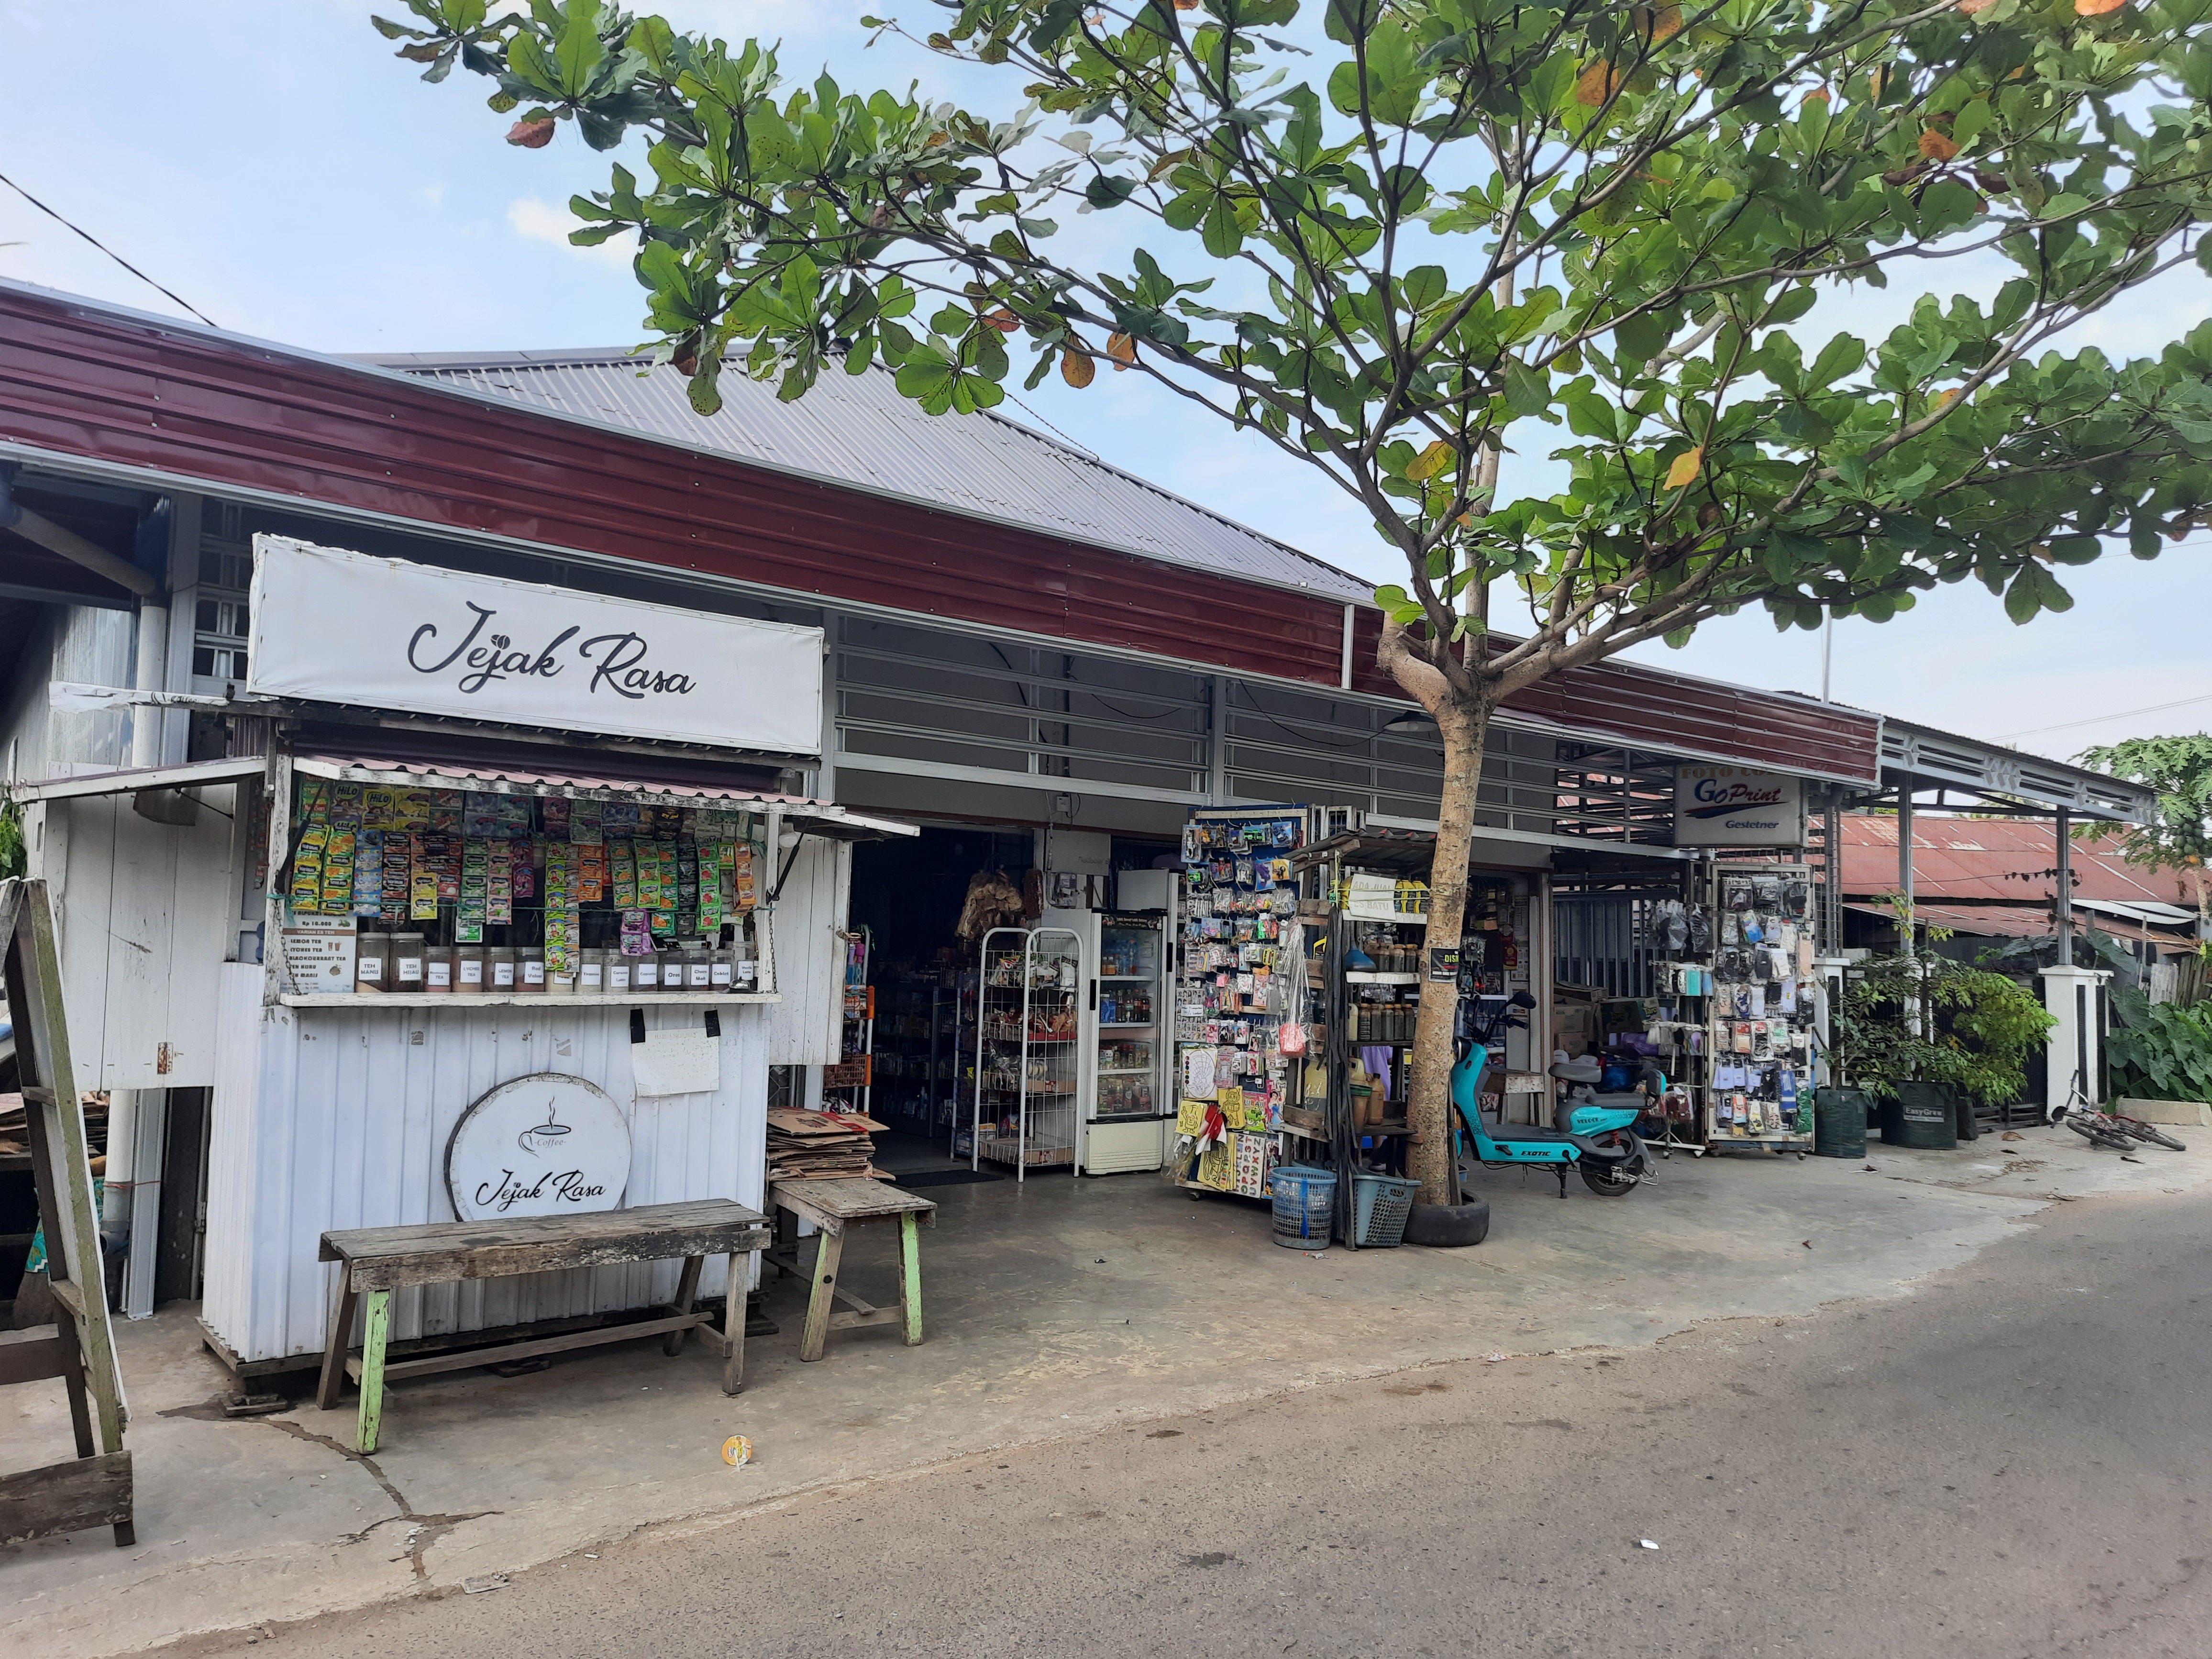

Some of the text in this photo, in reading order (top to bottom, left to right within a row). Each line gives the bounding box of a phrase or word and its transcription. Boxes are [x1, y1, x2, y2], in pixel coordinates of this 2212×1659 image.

[408, 600, 697, 699] Jejak Rasa
[1681, 766, 1733, 779] FOTO
[337, 786, 358, 796] HiLo
[1694, 778, 1782, 804] GoPrint
[369, 793, 389, 803] HiLo
[1725, 820, 1779, 829] Gestetner
[1367, 902, 1389, 910] BATU
[476, 1169, 606, 1212] Jejak Rasa
